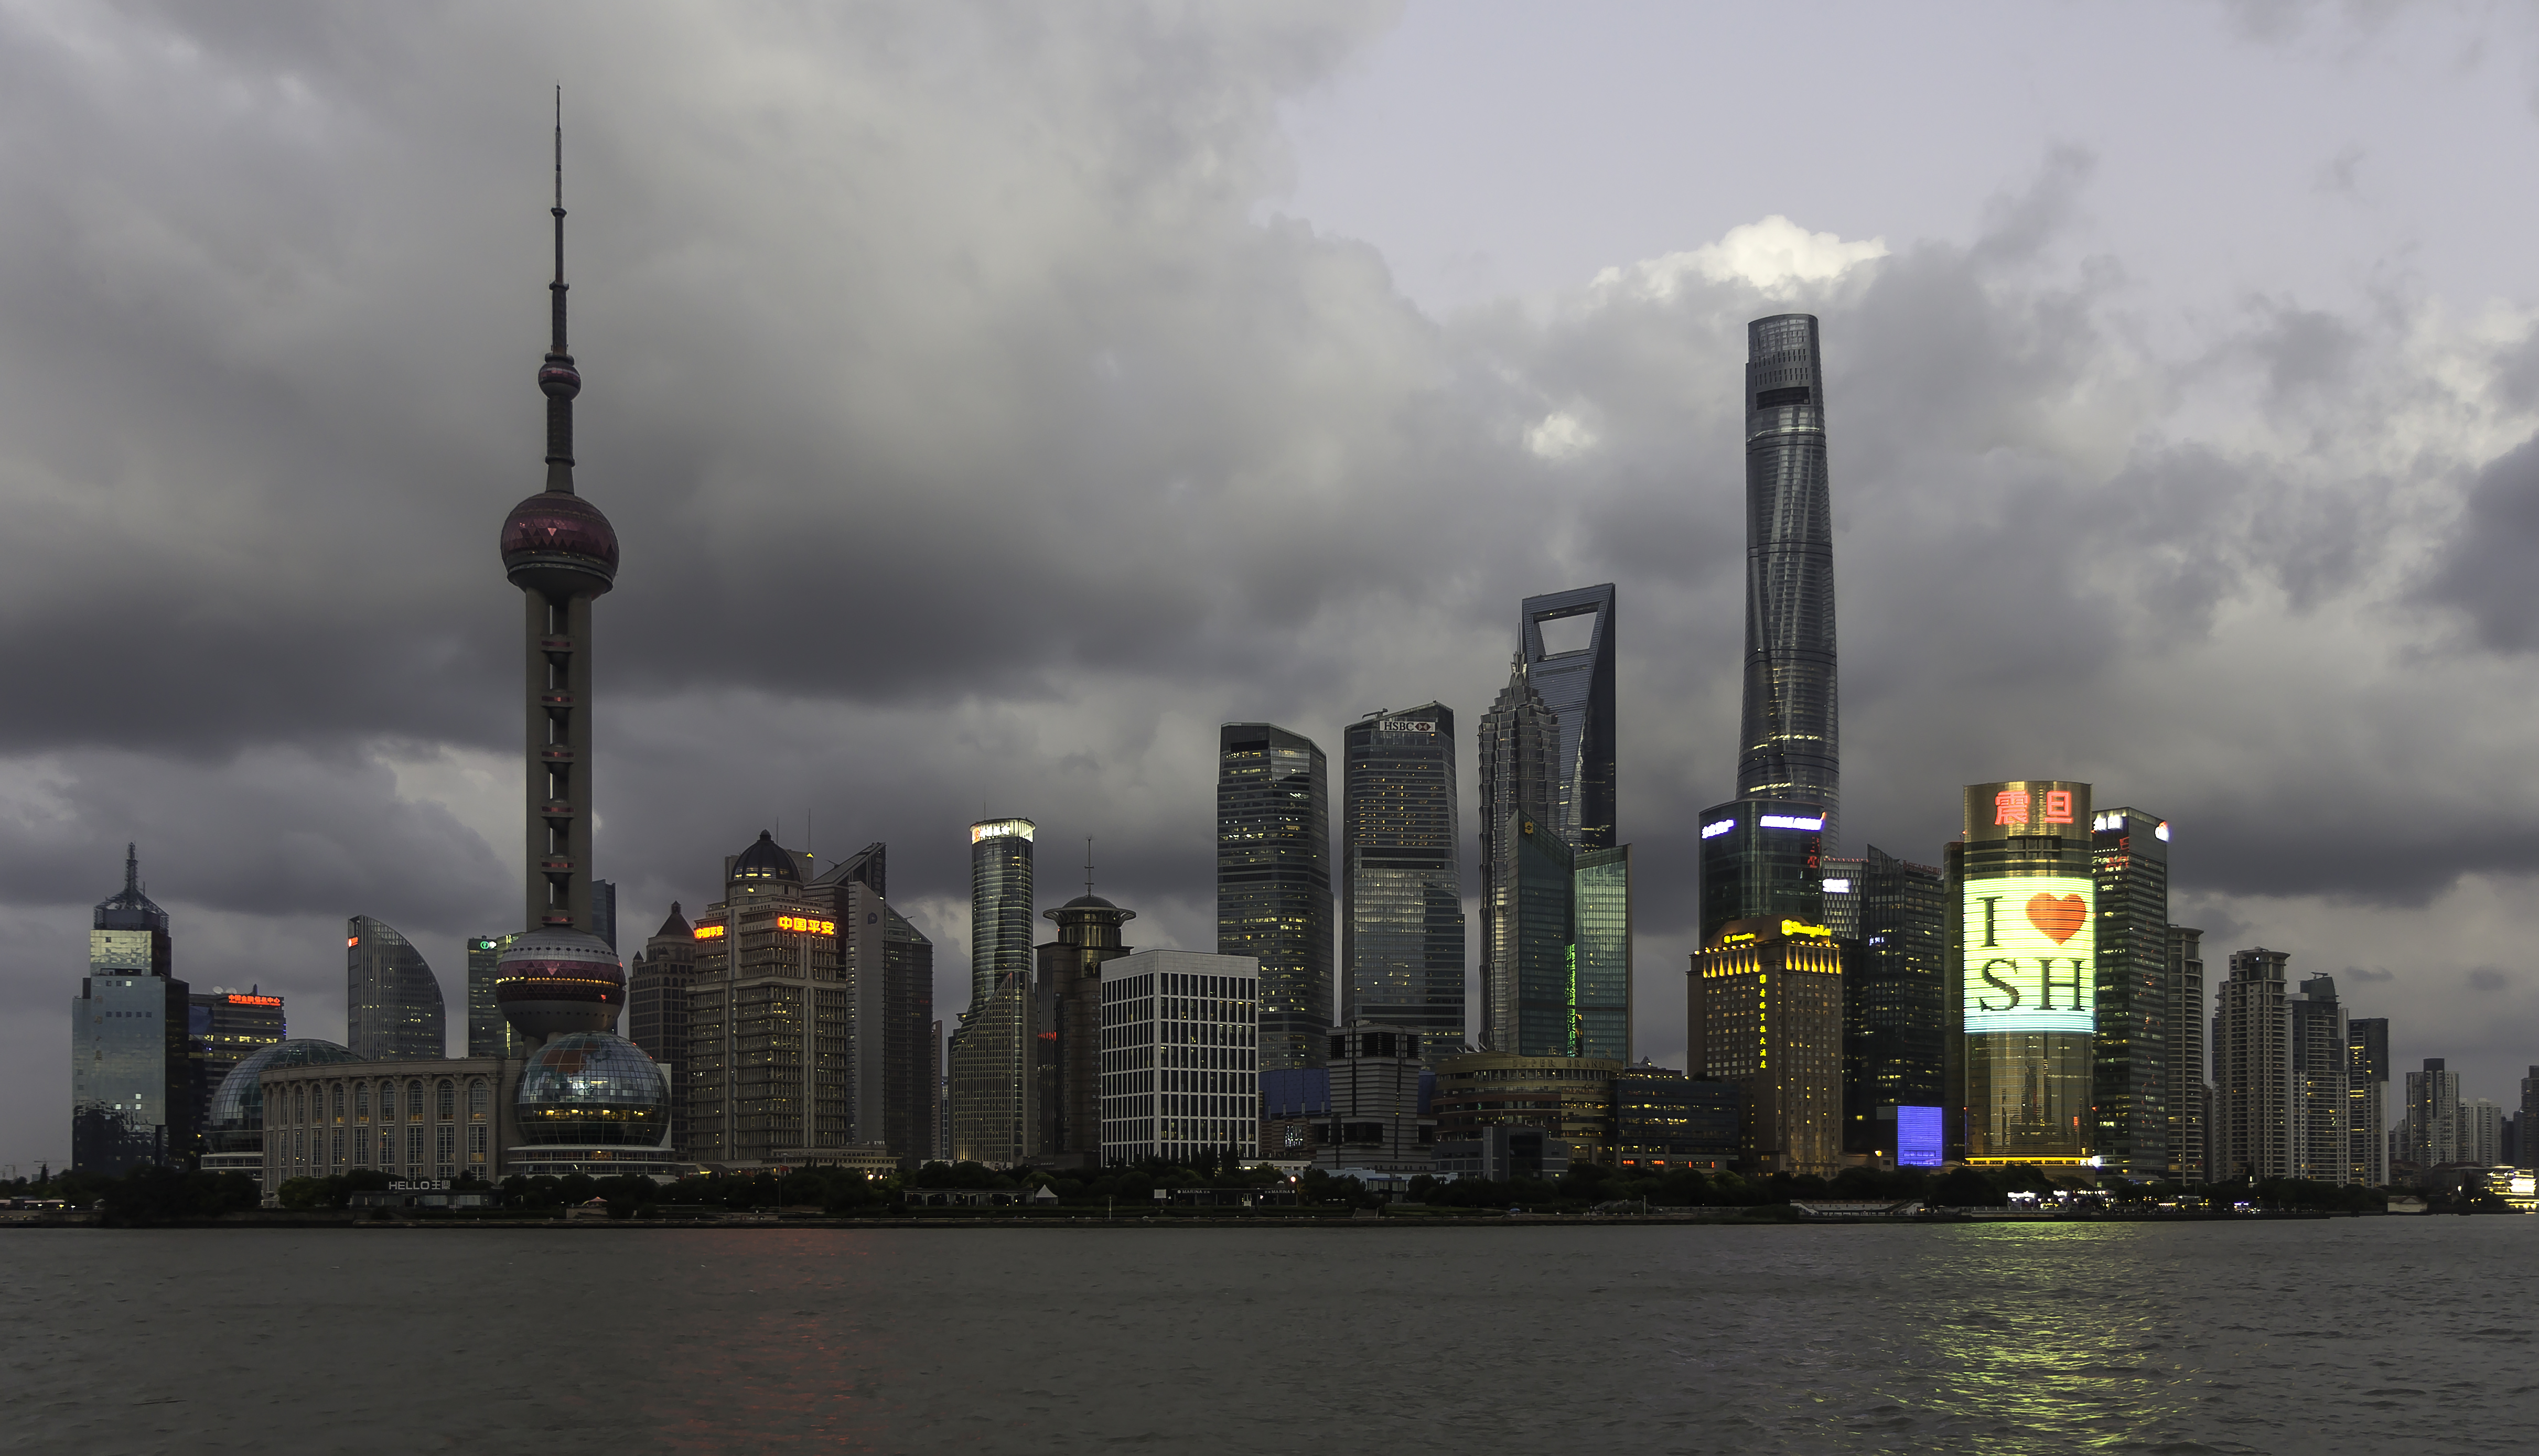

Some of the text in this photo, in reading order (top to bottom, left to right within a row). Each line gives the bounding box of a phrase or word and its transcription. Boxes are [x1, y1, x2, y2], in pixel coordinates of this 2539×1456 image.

[1384, 721, 1414, 731] HSBC
[1995, 791, 2073, 825] 震旦
[778, 916, 834, 935] 中国平安
[1976, 896, 2003, 947] I
[1979, 958, 2086, 1011] SH
[1567, 1059, 1605, 1068] BRAND
